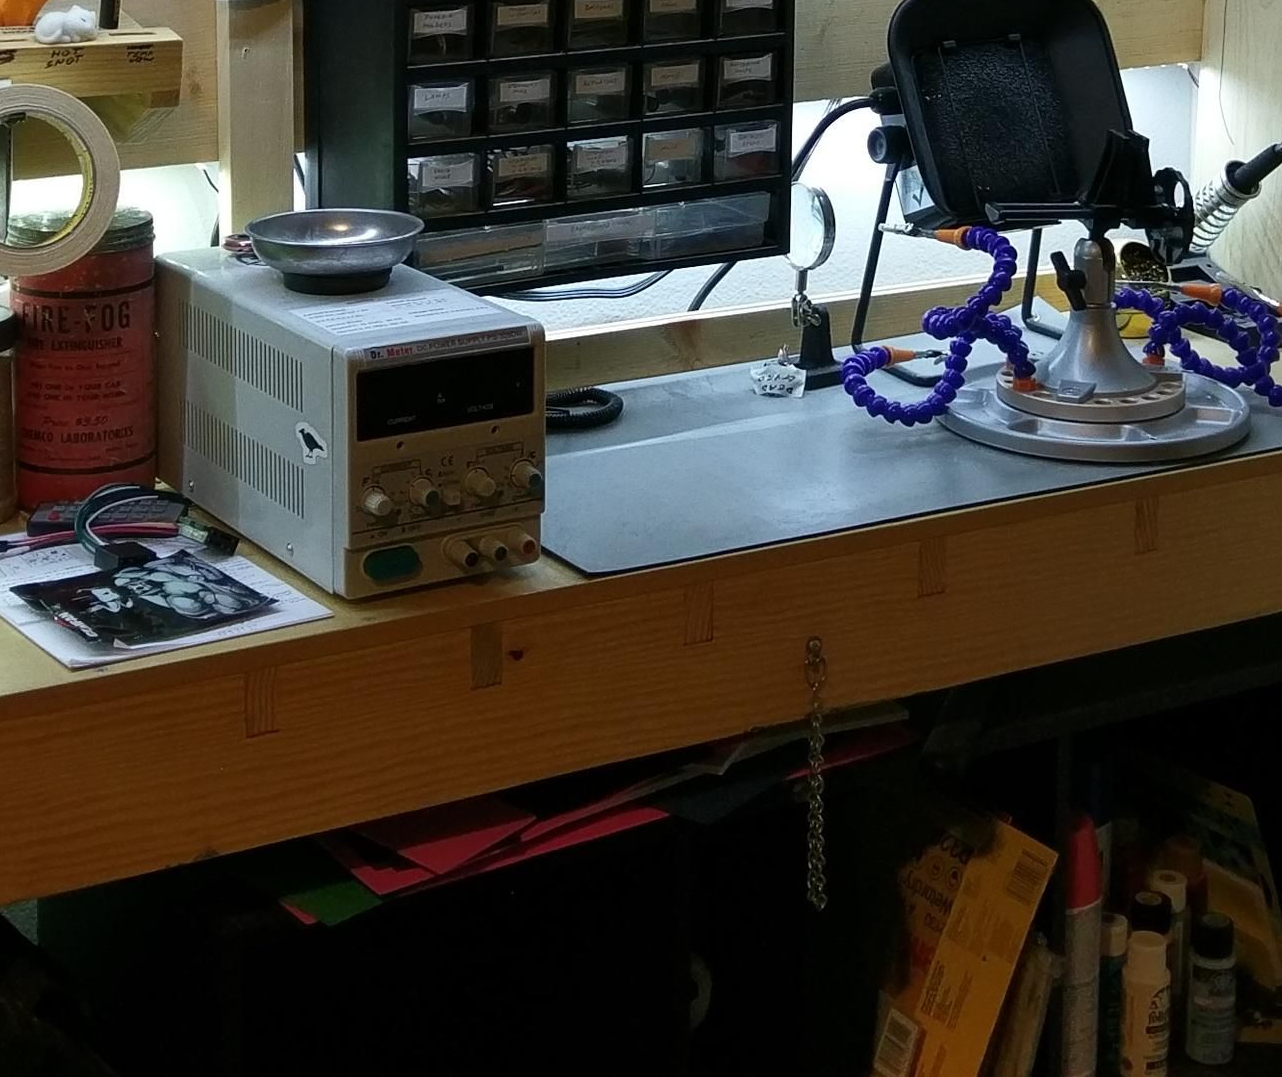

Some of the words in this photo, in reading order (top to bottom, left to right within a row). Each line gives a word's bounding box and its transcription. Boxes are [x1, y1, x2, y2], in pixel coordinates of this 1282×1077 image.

[50, 48, 85, 59] HOT
[46, 55, 84, 69] SNOT
[51, 337, 123, 352] EXTINGUISHER
[370, 350, 384, 360] Dr.
[386, 346, 414, 358] Meter
[60, 425, 134, 444] LABORATORIES
